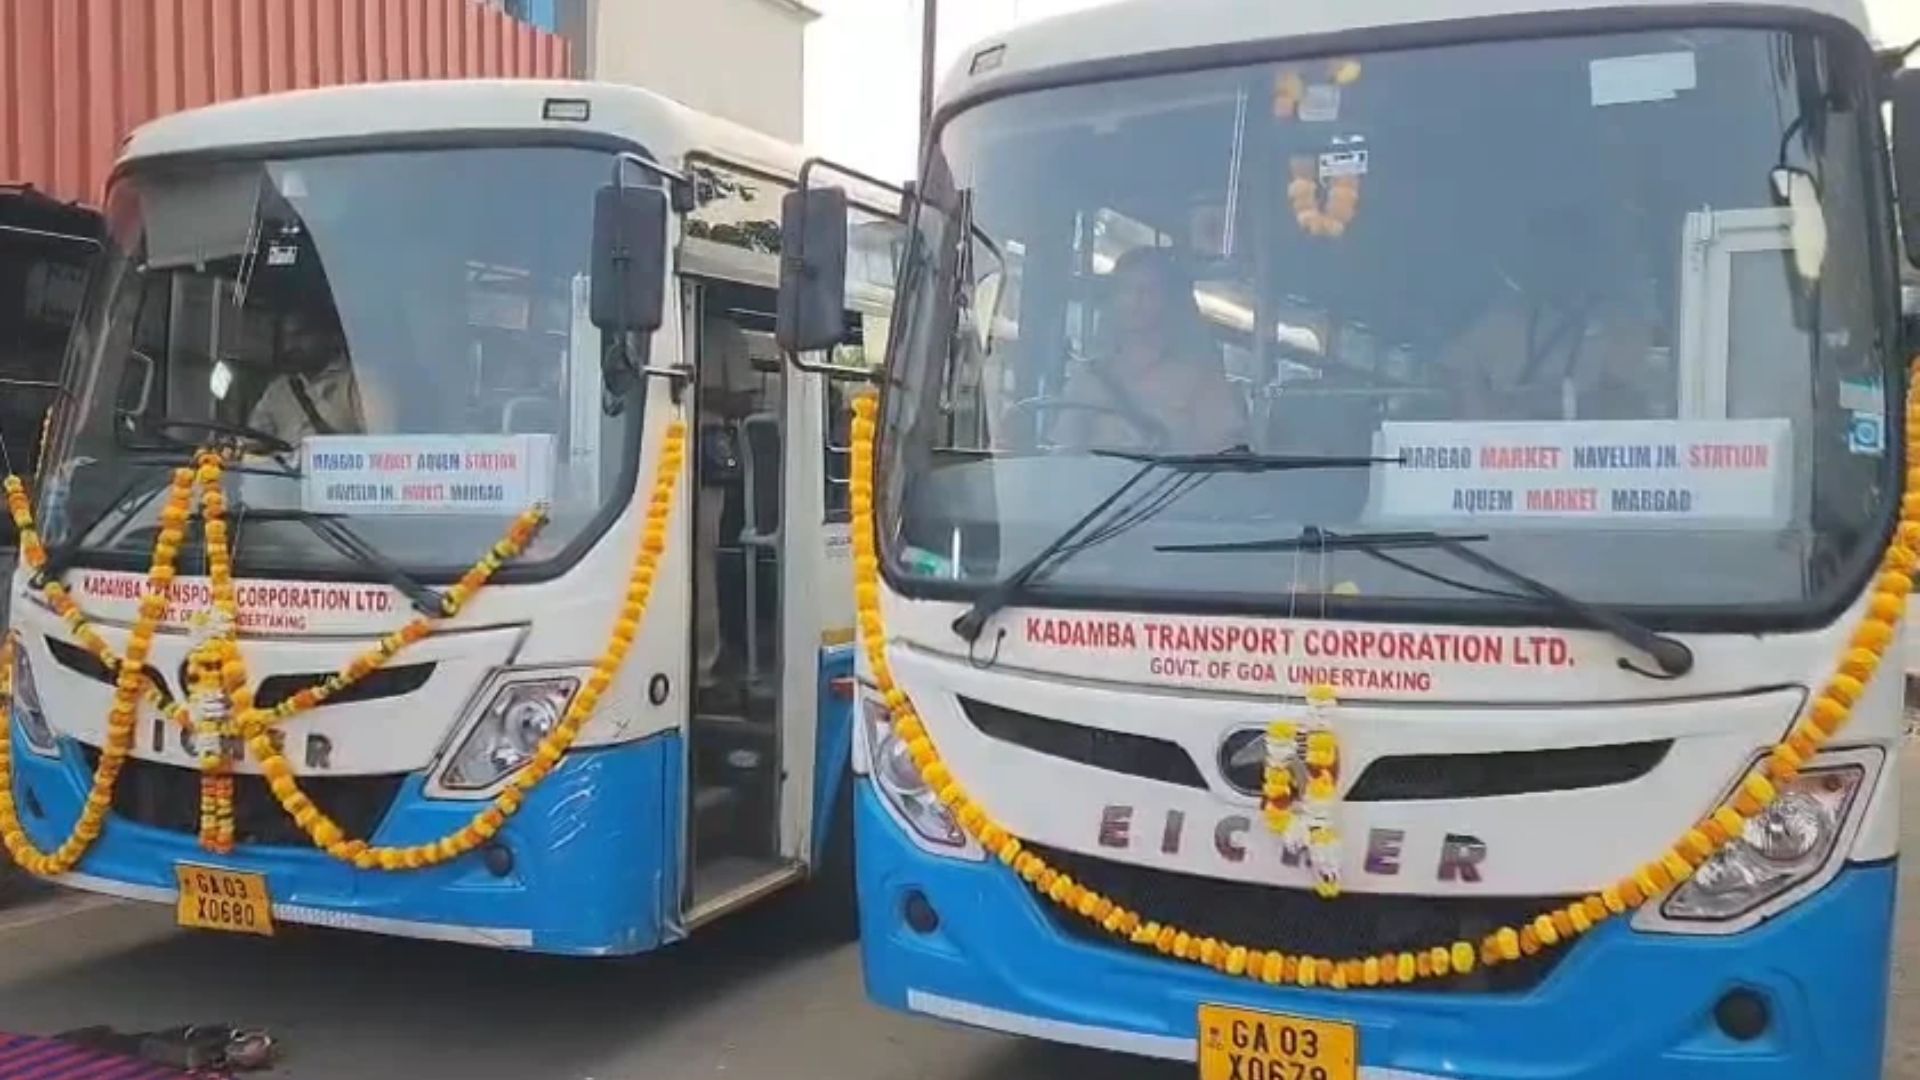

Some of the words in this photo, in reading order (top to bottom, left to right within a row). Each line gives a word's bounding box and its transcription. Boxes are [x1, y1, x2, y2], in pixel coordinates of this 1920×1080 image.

[417, 454, 460, 471] AQUEM
[465, 454, 517, 470] STATION
[1399, 446, 1472, 470] MARGAO
[1480, 446, 1560, 470] MARKET
[1573, 445, 1651, 469] NAVELIM
[1688, 444, 1770, 468] STATION
[1453, 489, 1514, 513] AQUEM
[1526, 488, 1598, 511] MARKET
[1611, 489, 1692, 512] MARGAO
[83, 576, 140, 600] KADAMBA
[236, 586, 350, 610] CORPORATION
[355, 591, 392, 612] LTD.
[1026, 617, 1137, 650] KADAMBA
[1144, 623, 1293, 656] TRANSPORT
[1304, 628, 1501, 664] CORPORATION
[1513, 636, 1575, 667] LTD.
[1150, 657, 1200, 677] GOVT.
[1208, 660, 1231, 680] OF
[1237, 662, 1277, 682] GOA
[1287, 665, 1430, 691] UNDERTAKING
[196, 873, 220, 895] GA
[223, 877, 247, 900] 03
[198, 896, 254, 928] X0680
[1232, 1019, 1269, 1054] GA
[1280, 1026, 1318, 1058] 03
